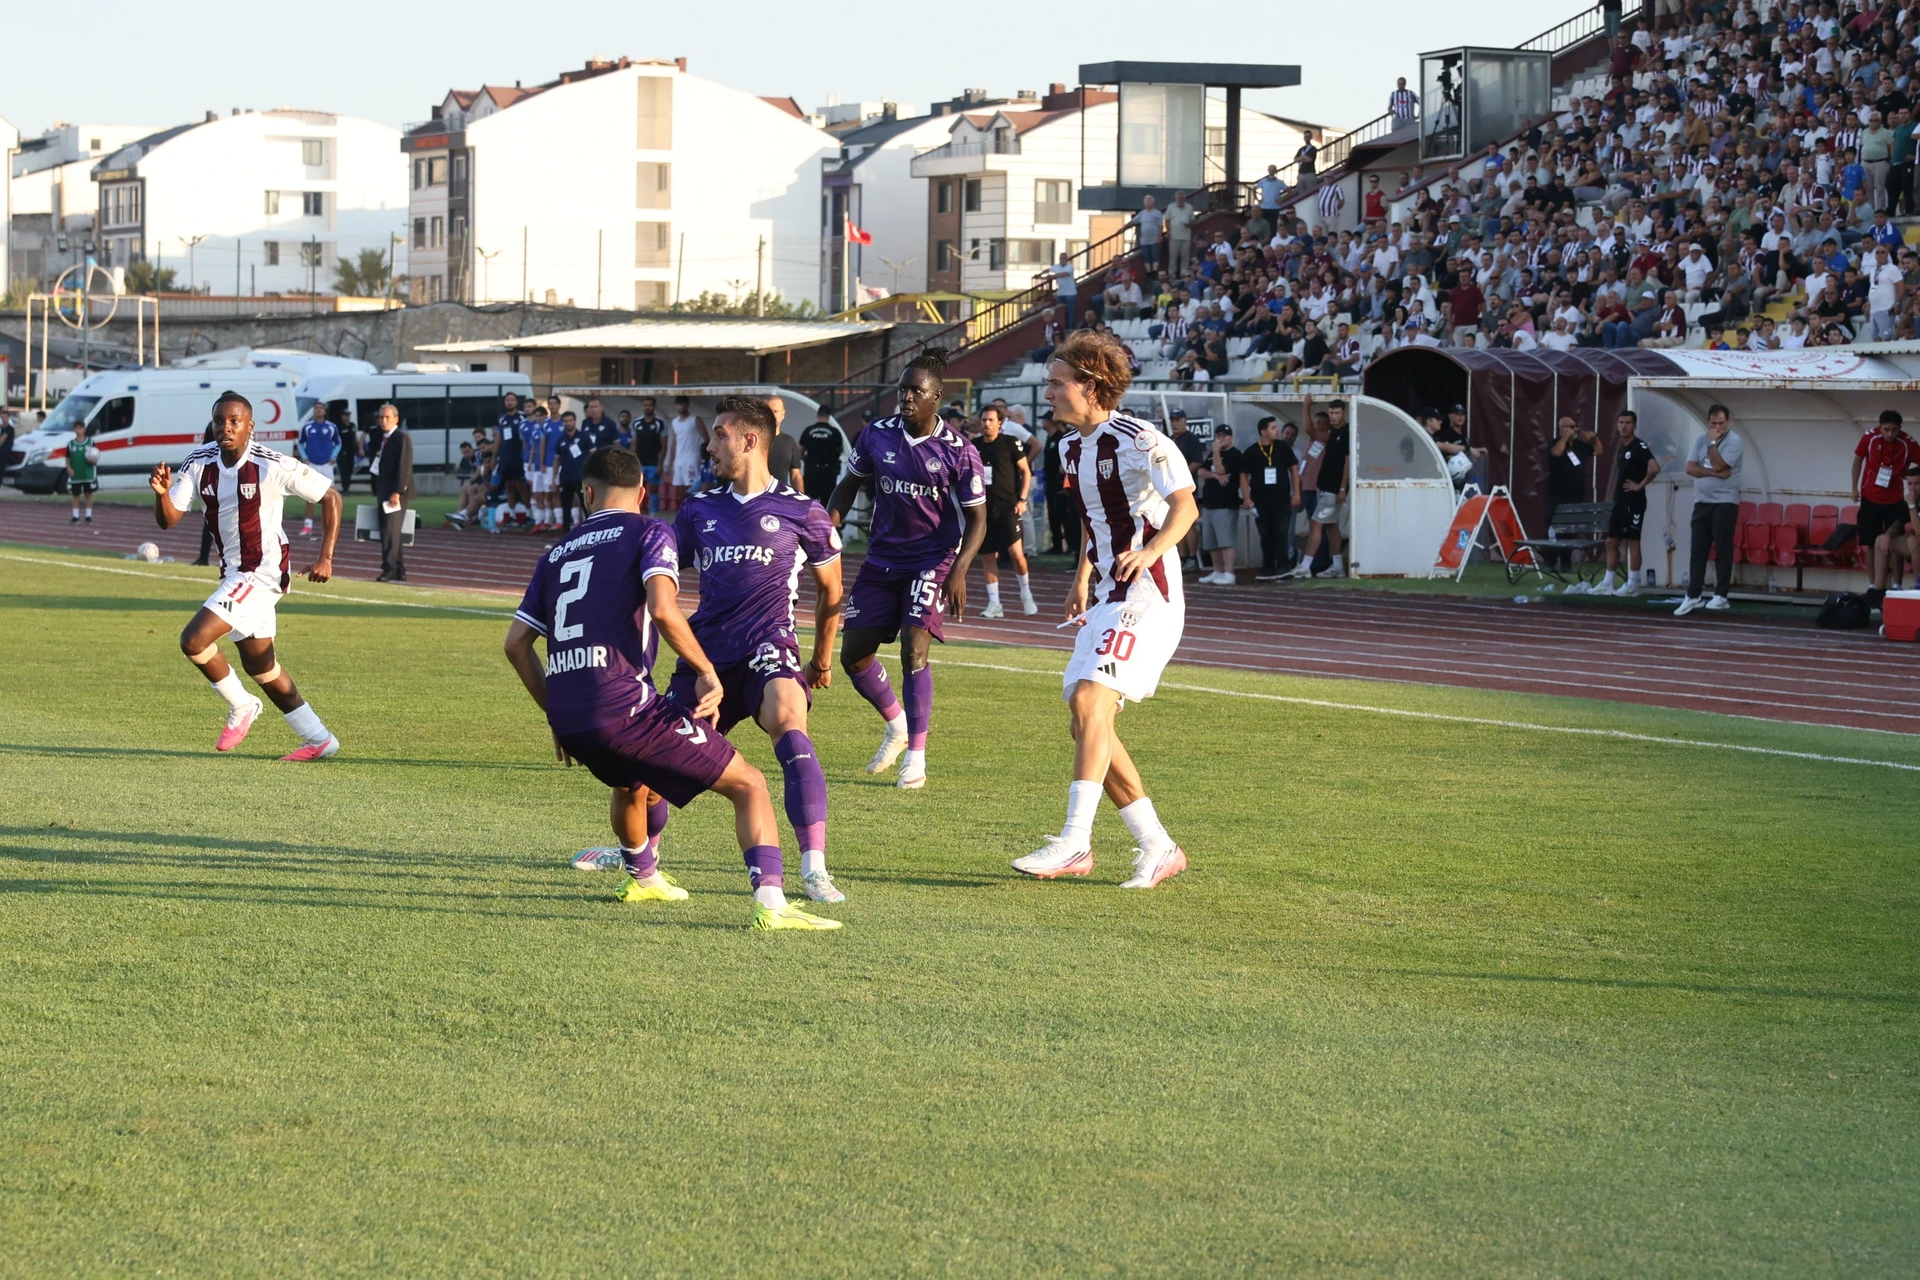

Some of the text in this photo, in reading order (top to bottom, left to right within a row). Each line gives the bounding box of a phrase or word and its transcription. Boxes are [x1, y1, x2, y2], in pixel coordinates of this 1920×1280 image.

[1186, 424, 1210, 436] VAR
[895, 479, 938, 501] KEÇTAŞ
[563, 526, 624, 554] POWERTEC
[714, 545, 774, 566] KEÇTAŞ
[228, 582, 254, 604] 11
[554, 555, 594, 642] 2
[910, 580, 938, 607] 45
[1095, 628, 1136, 661] 30
